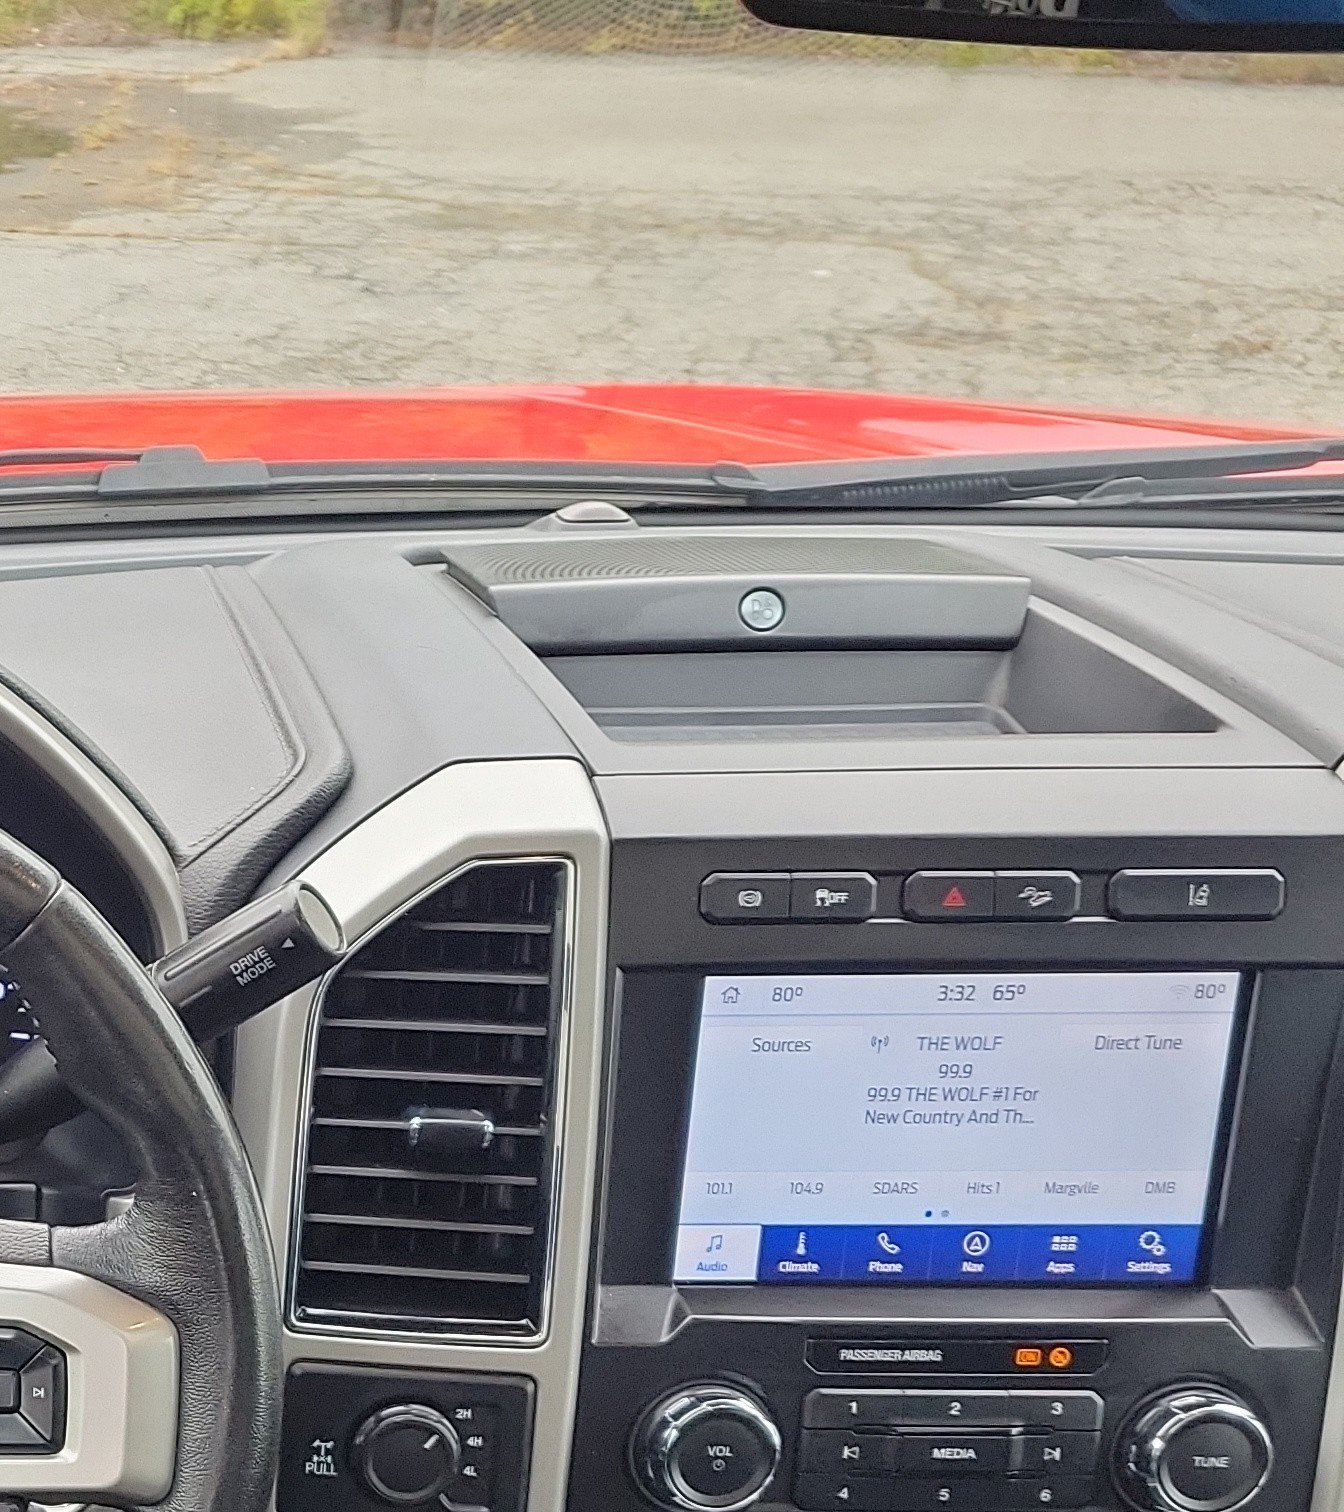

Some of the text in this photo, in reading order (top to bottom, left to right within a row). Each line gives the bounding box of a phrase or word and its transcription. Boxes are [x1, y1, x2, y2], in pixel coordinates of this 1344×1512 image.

[229, 945, 268, 975] DRIVE
[235, 957, 277, 987] MODE
[936, 984, 976, 1002] 3:32
[751, 1036, 812, 1054] Sources
[917, 1036, 1003, 1051] THE WOLF
[1094, 1033, 1183, 1051] Direct Tune
[938, 1063, 973, 1080] 99.9
[866, 1086, 1040, 1102] 99.9 THE WOLF #1 For
[864, 1110, 899, 1125] New
[902, 1109, 964, 1128] Country
[967, 1109, 1000, 1125] And
[705, 1182, 734, 1195] 101.1
[789, 1182, 825, 1195] 104.9
[872, 1181, 919, 1195] SDARS
[966, 1181, 994, 1195] Hits
[696, 1261, 728, 1273] Audio
[778, 1260, 821, 1273] Climate
[868, 1260, 904, 1273] Phone
[962, 1260, 985, 1273] Nav
[1046, 1260, 1076, 1275] Apps
[1126, 1260, 1172, 1275] Settings
[839, 1348, 944, 1363] PASSENGER AIRBAG
[454, 1408, 473, 1420] 2H
[847, 1401, 859, 1416] 1
[947, 1401, 961, 1416] 2
[1050, 1401, 1064, 1416] 3
[466, 1436, 484, 1448] 4H
[707, 1445, 733, 1458] VOL
[932, 1447, 977, 1461] MEDIA
[304, 1462, 339, 1477] PULL
[1192, 1456, 1230, 1469] TUNE
[463, 1465, 479, 1477] 4L
[837, 1488, 850, 1501] 4
[938, 1488, 951, 1502] 5
[1039, 1488, 1052, 1502] 6
